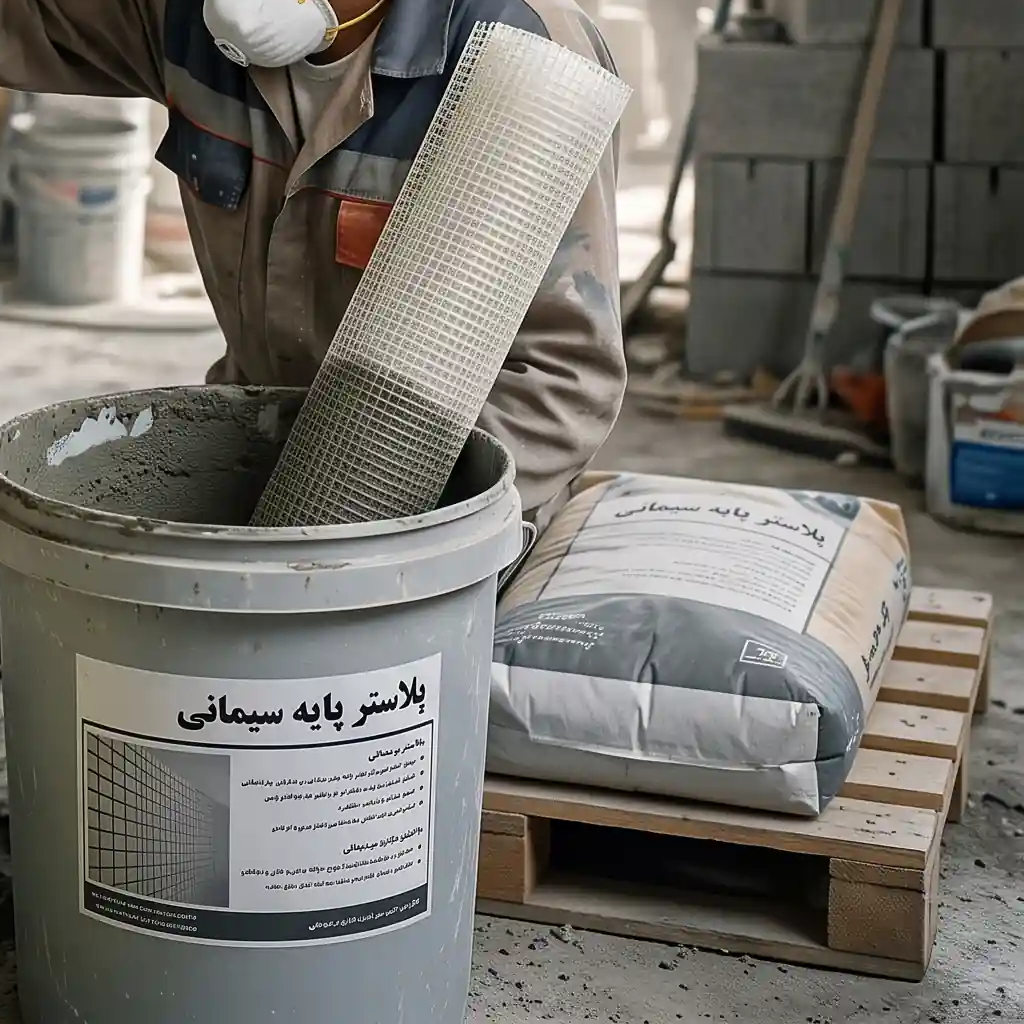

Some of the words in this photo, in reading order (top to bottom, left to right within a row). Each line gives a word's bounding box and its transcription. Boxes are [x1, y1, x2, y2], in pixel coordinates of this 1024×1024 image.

[177, 694, 284, 734] سیمانی
[292, 692, 345, 732] پایه
[350, 676, 426, 728] پلاستر
